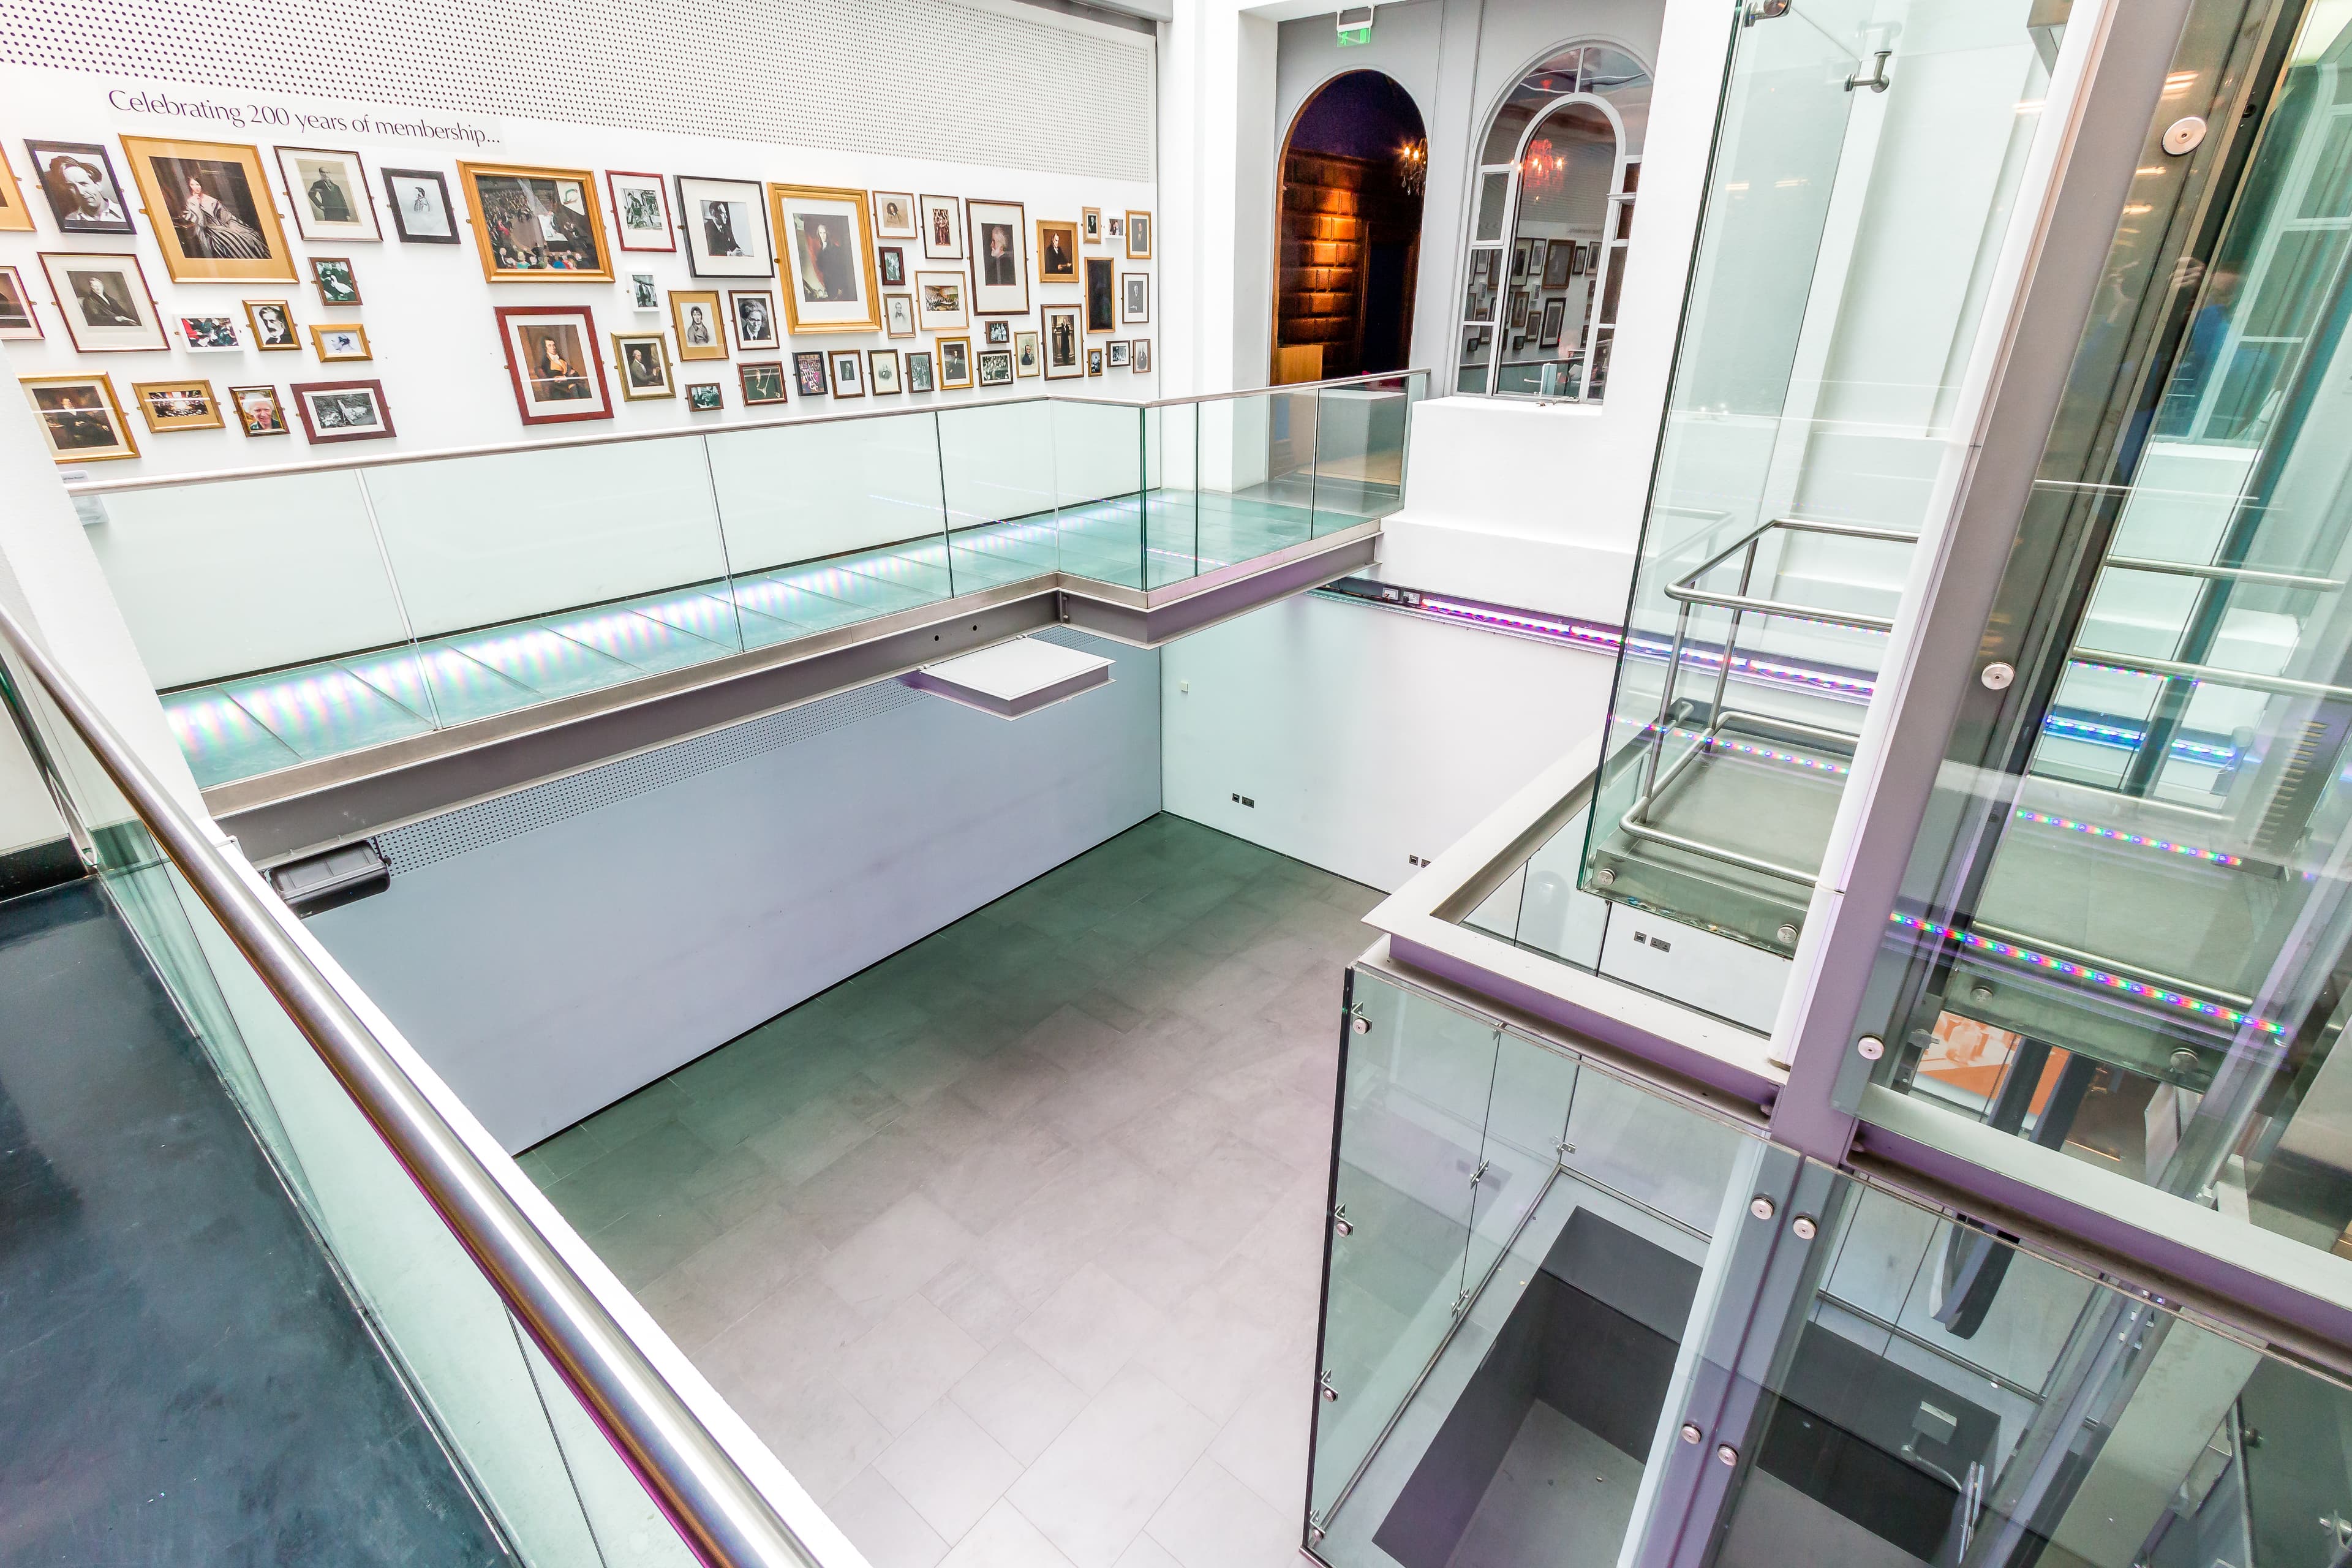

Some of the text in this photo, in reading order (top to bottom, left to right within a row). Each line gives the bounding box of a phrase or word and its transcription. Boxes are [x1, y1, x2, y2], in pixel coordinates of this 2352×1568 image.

[108, 89, 500, 148] Celebrating 200 years of membership...
